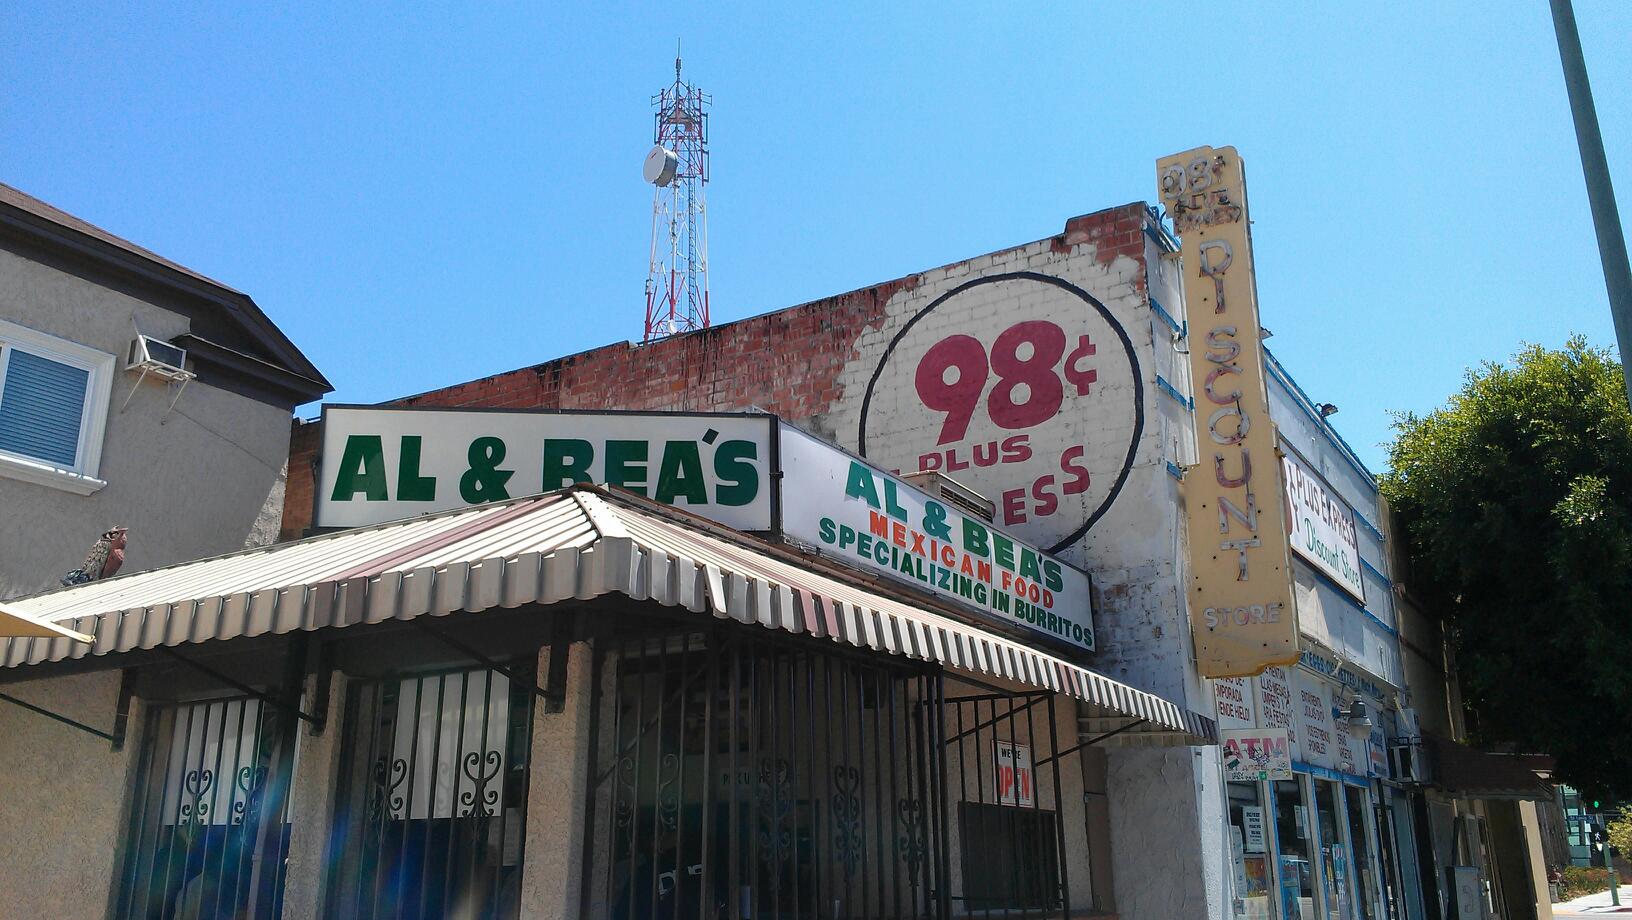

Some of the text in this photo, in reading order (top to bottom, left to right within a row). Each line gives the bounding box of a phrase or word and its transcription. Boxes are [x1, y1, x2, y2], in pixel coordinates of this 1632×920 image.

[1199, 239, 1262, 581] DISCOUNT
[331, 428, 759, 506] AL & BEA'S
[919, 434, 1033, 475] PLUS
[845, 460, 1064, 593] AL & BEA'S
[1295, 463, 1321, 518] PLUS
[1320, 486, 1357, 551] EXPRESS
[819, 517, 1093, 647] SPECIALIZING IN BURRITOS
[870, 510, 1054, 609] MEXICAN FOOD
[1304, 517, 1361, 591] Discount Store
[1203, 602, 1285, 628] STORE
[1223, 737, 1289, 760] ATM
